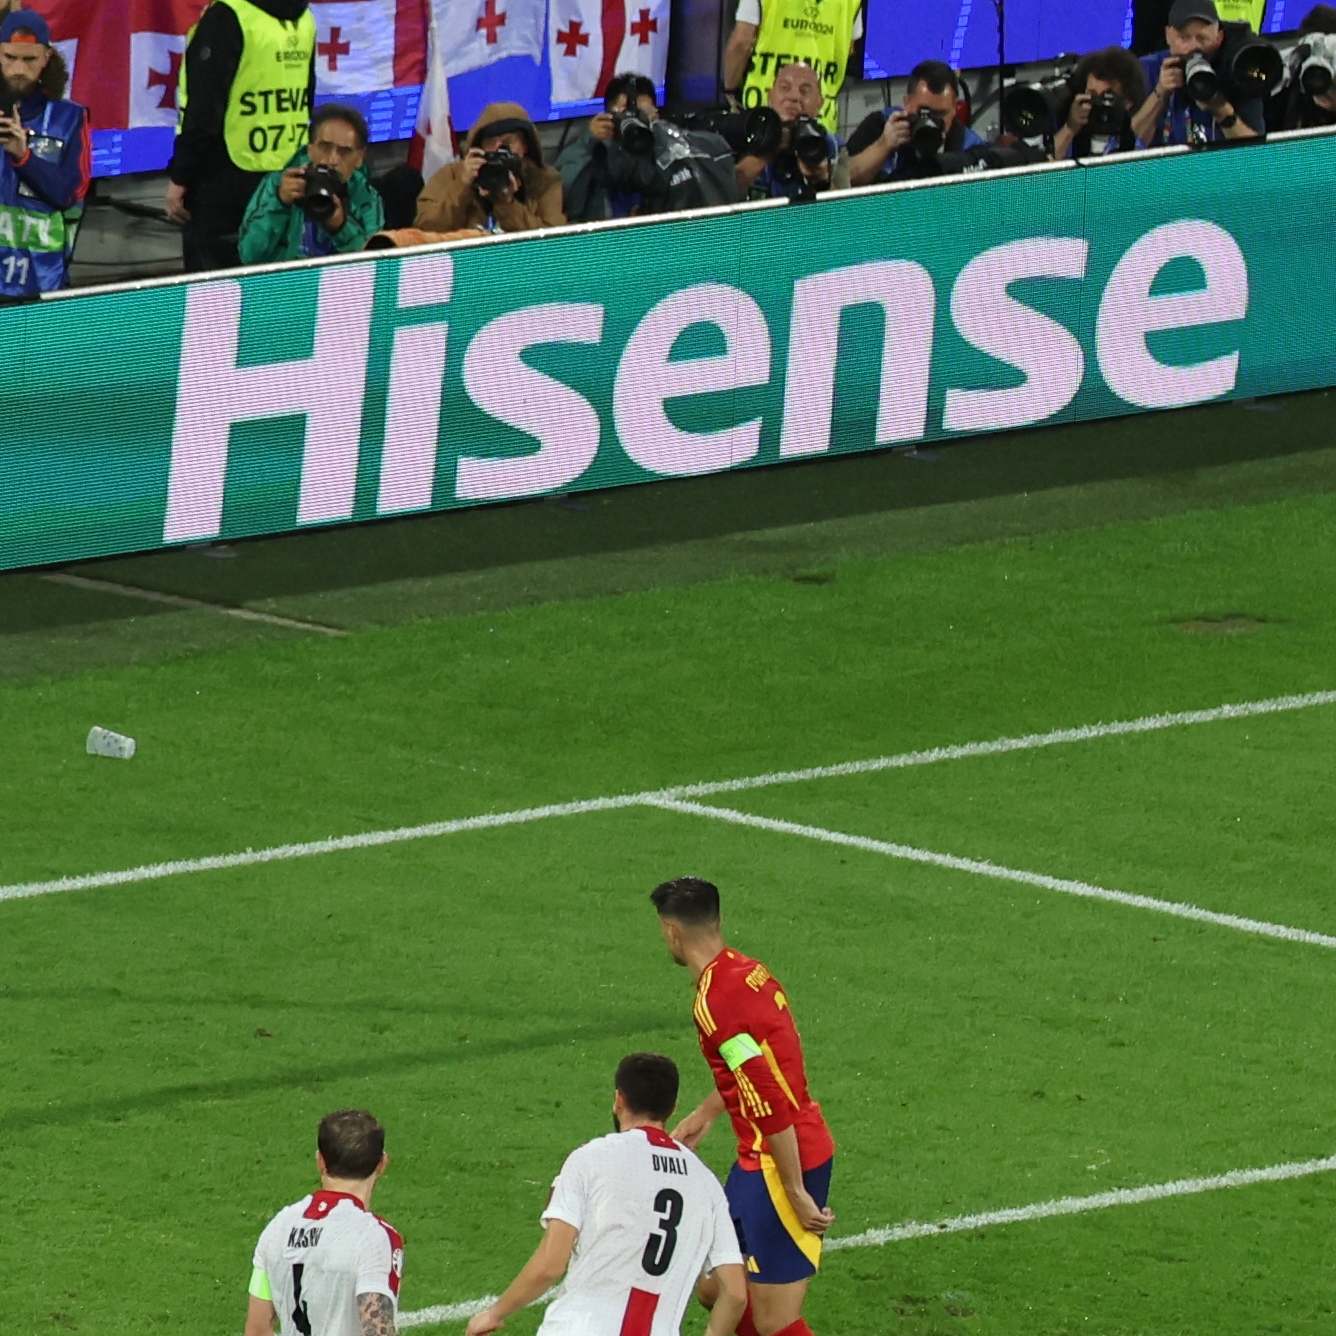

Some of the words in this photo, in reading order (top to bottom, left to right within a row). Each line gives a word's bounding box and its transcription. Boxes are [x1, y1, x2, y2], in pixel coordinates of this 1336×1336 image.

[162, 217, 1250, 543] Hisense
[652, 1154, 688, 1176] DVALI
[642, 1188, 684, 1276] 3
